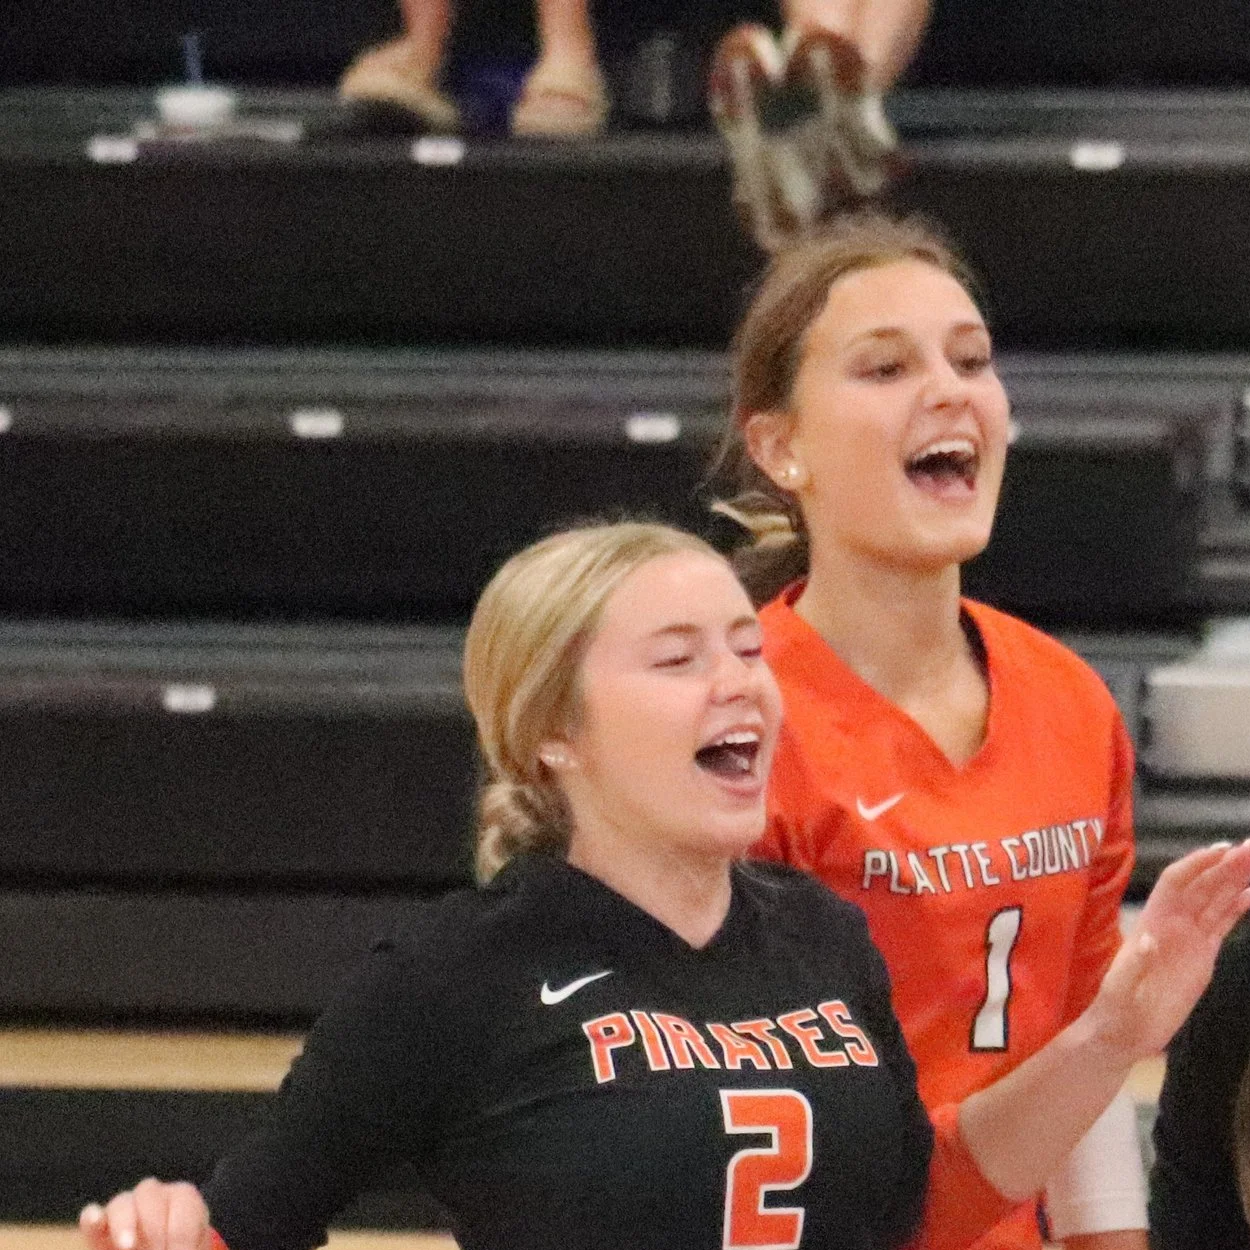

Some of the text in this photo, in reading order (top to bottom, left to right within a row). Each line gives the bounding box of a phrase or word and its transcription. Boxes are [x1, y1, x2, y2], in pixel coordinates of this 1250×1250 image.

[861, 842, 1000, 895] PLATTE
[968, 905, 1024, 1053] 1
[581, 1000, 879, 1084] PIRATES
